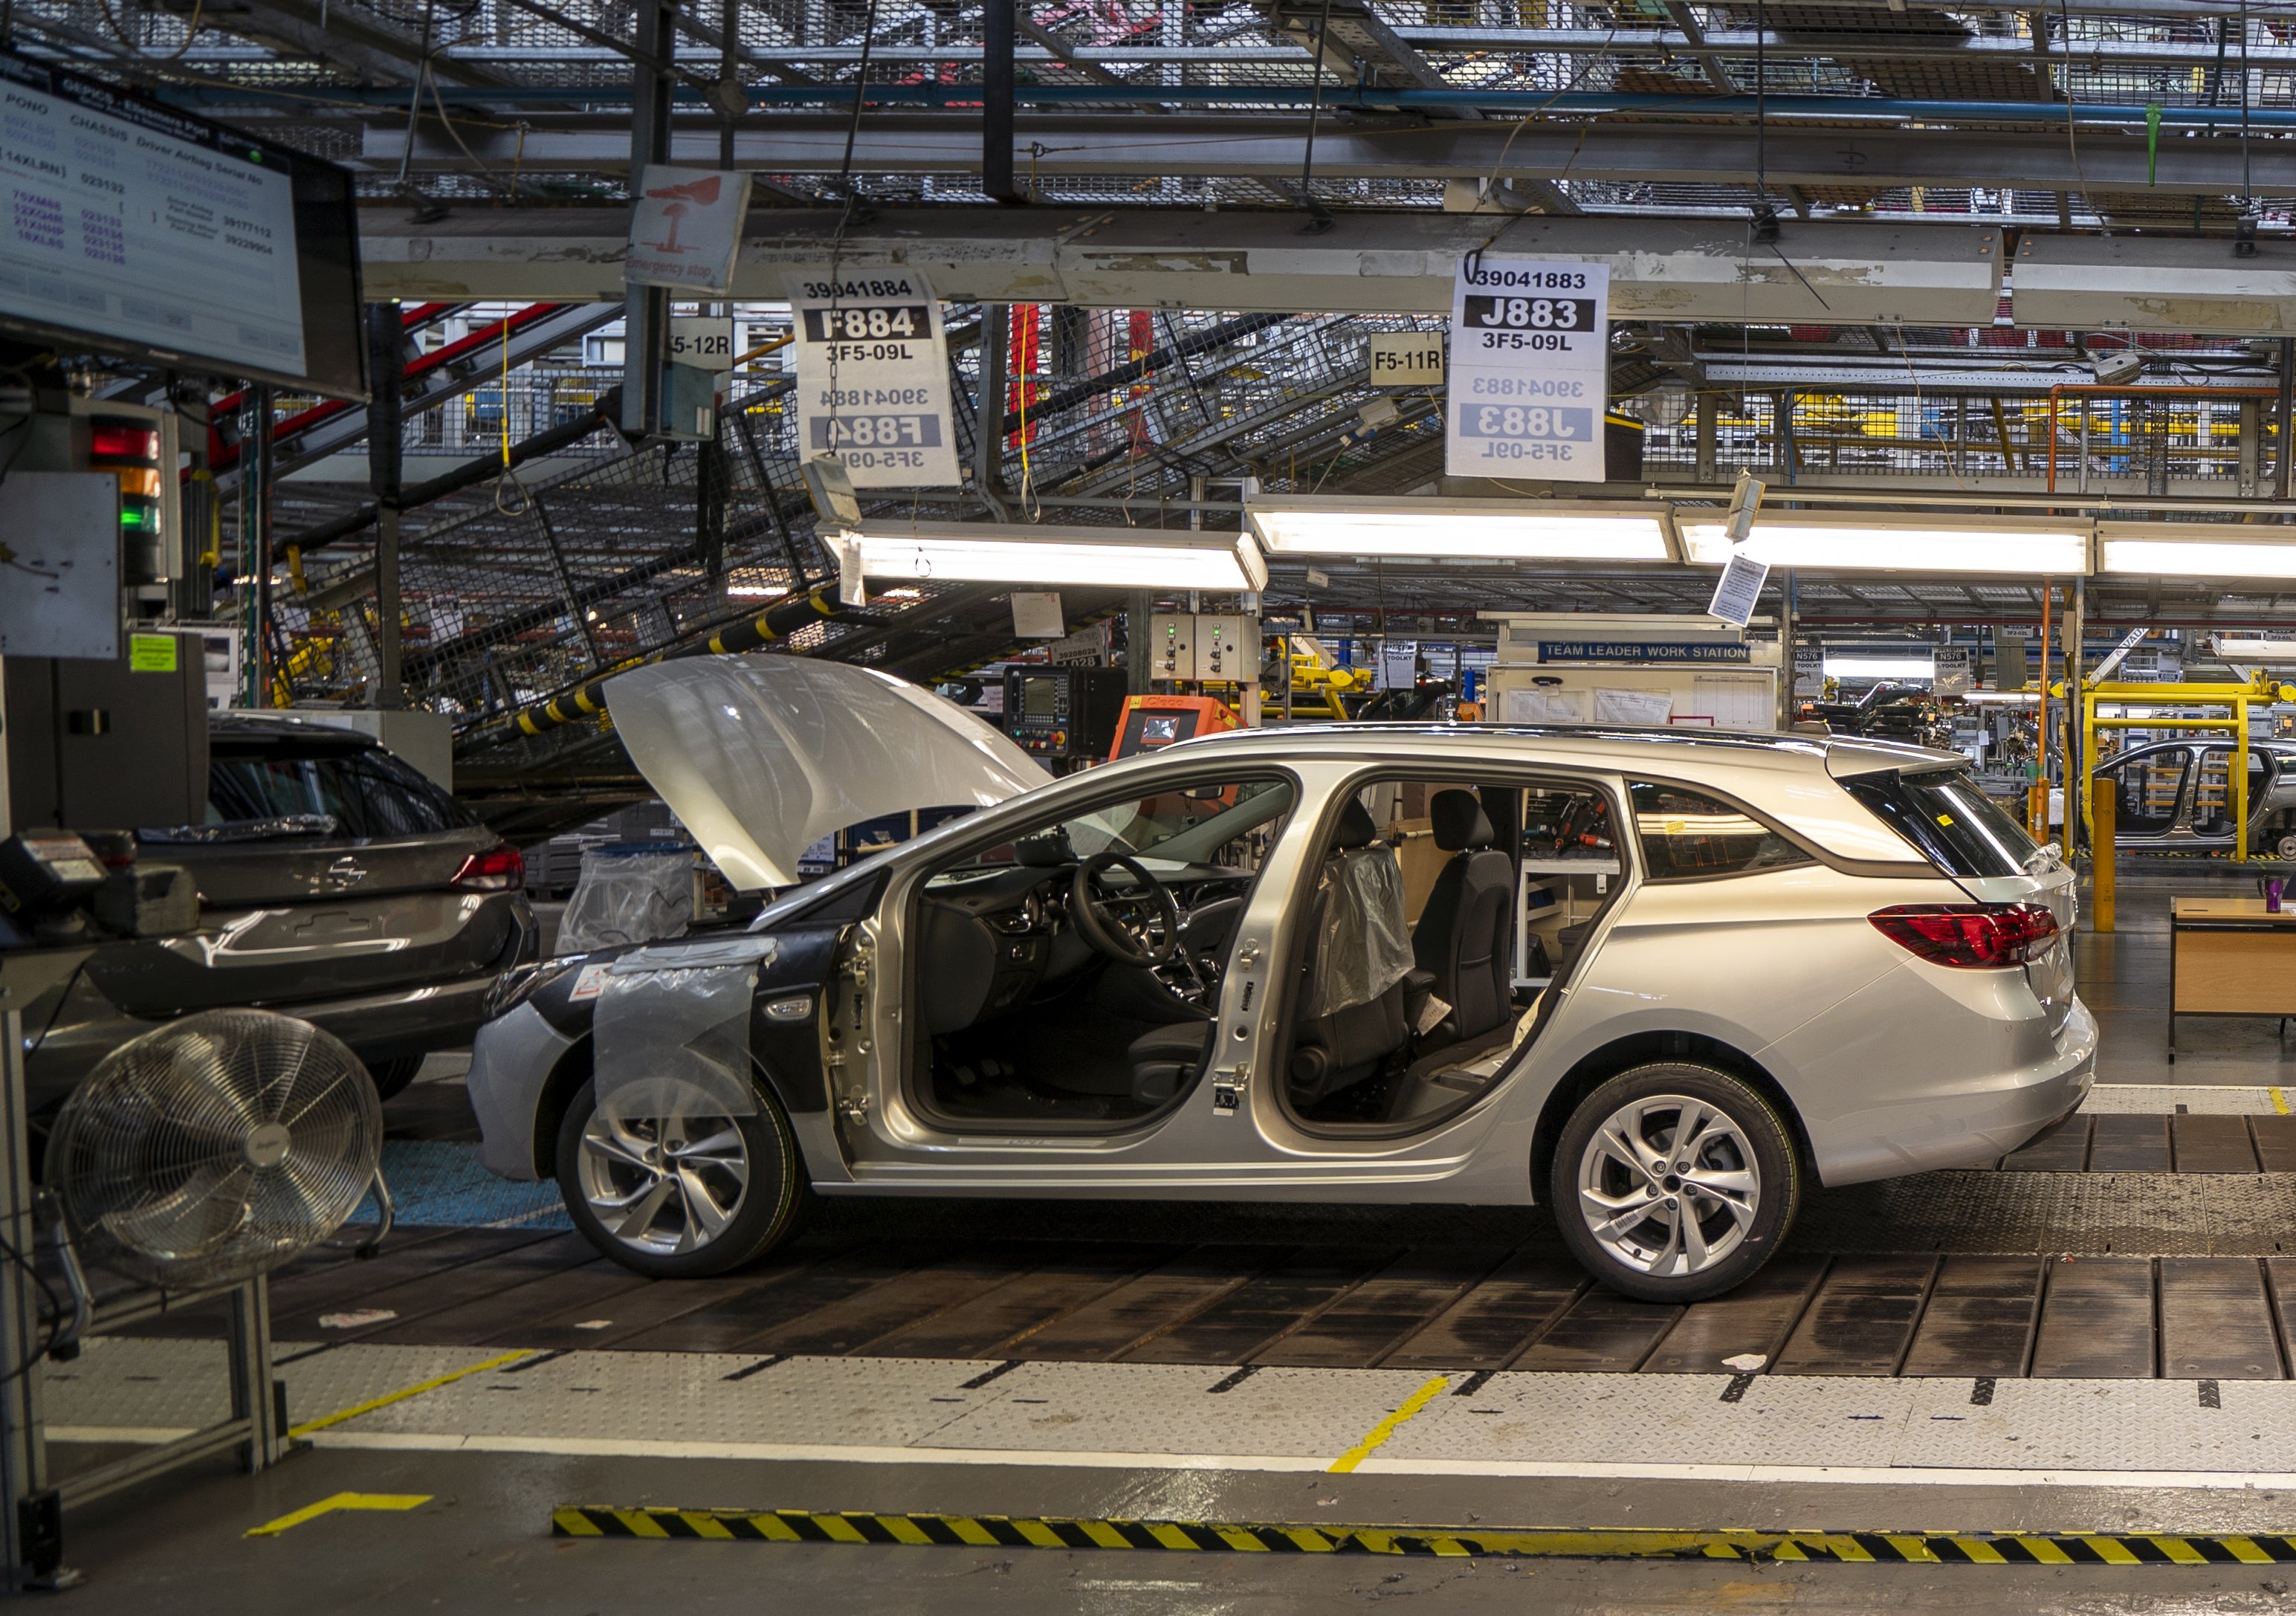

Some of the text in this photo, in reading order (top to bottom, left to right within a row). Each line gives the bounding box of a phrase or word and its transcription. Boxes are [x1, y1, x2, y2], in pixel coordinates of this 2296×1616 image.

[70, 114, 129, 142] CHASSIS
[137, 135, 263, 185] Driver Airbag Serial No
[626, 257, 711, 279] Emergency stop
[803, 279, 913, 299] 39041884
[1476, 270, 1586, 289] 39041883
[821, 307, 915, 339] F884
[1481, 297, 1577, 329] J883
[670, 334, 729, 355] 5-12R
[1482, 332, 1573, 352] 3F5-09L
[827, 343, 913, 362] 3F5-09L
[1375, 350, 1440, 370] F5-11R
[1058, 647, 1097, 659] 39208028
[1546, 644, 1747, 659] TEAM LEADER WORK STATION
